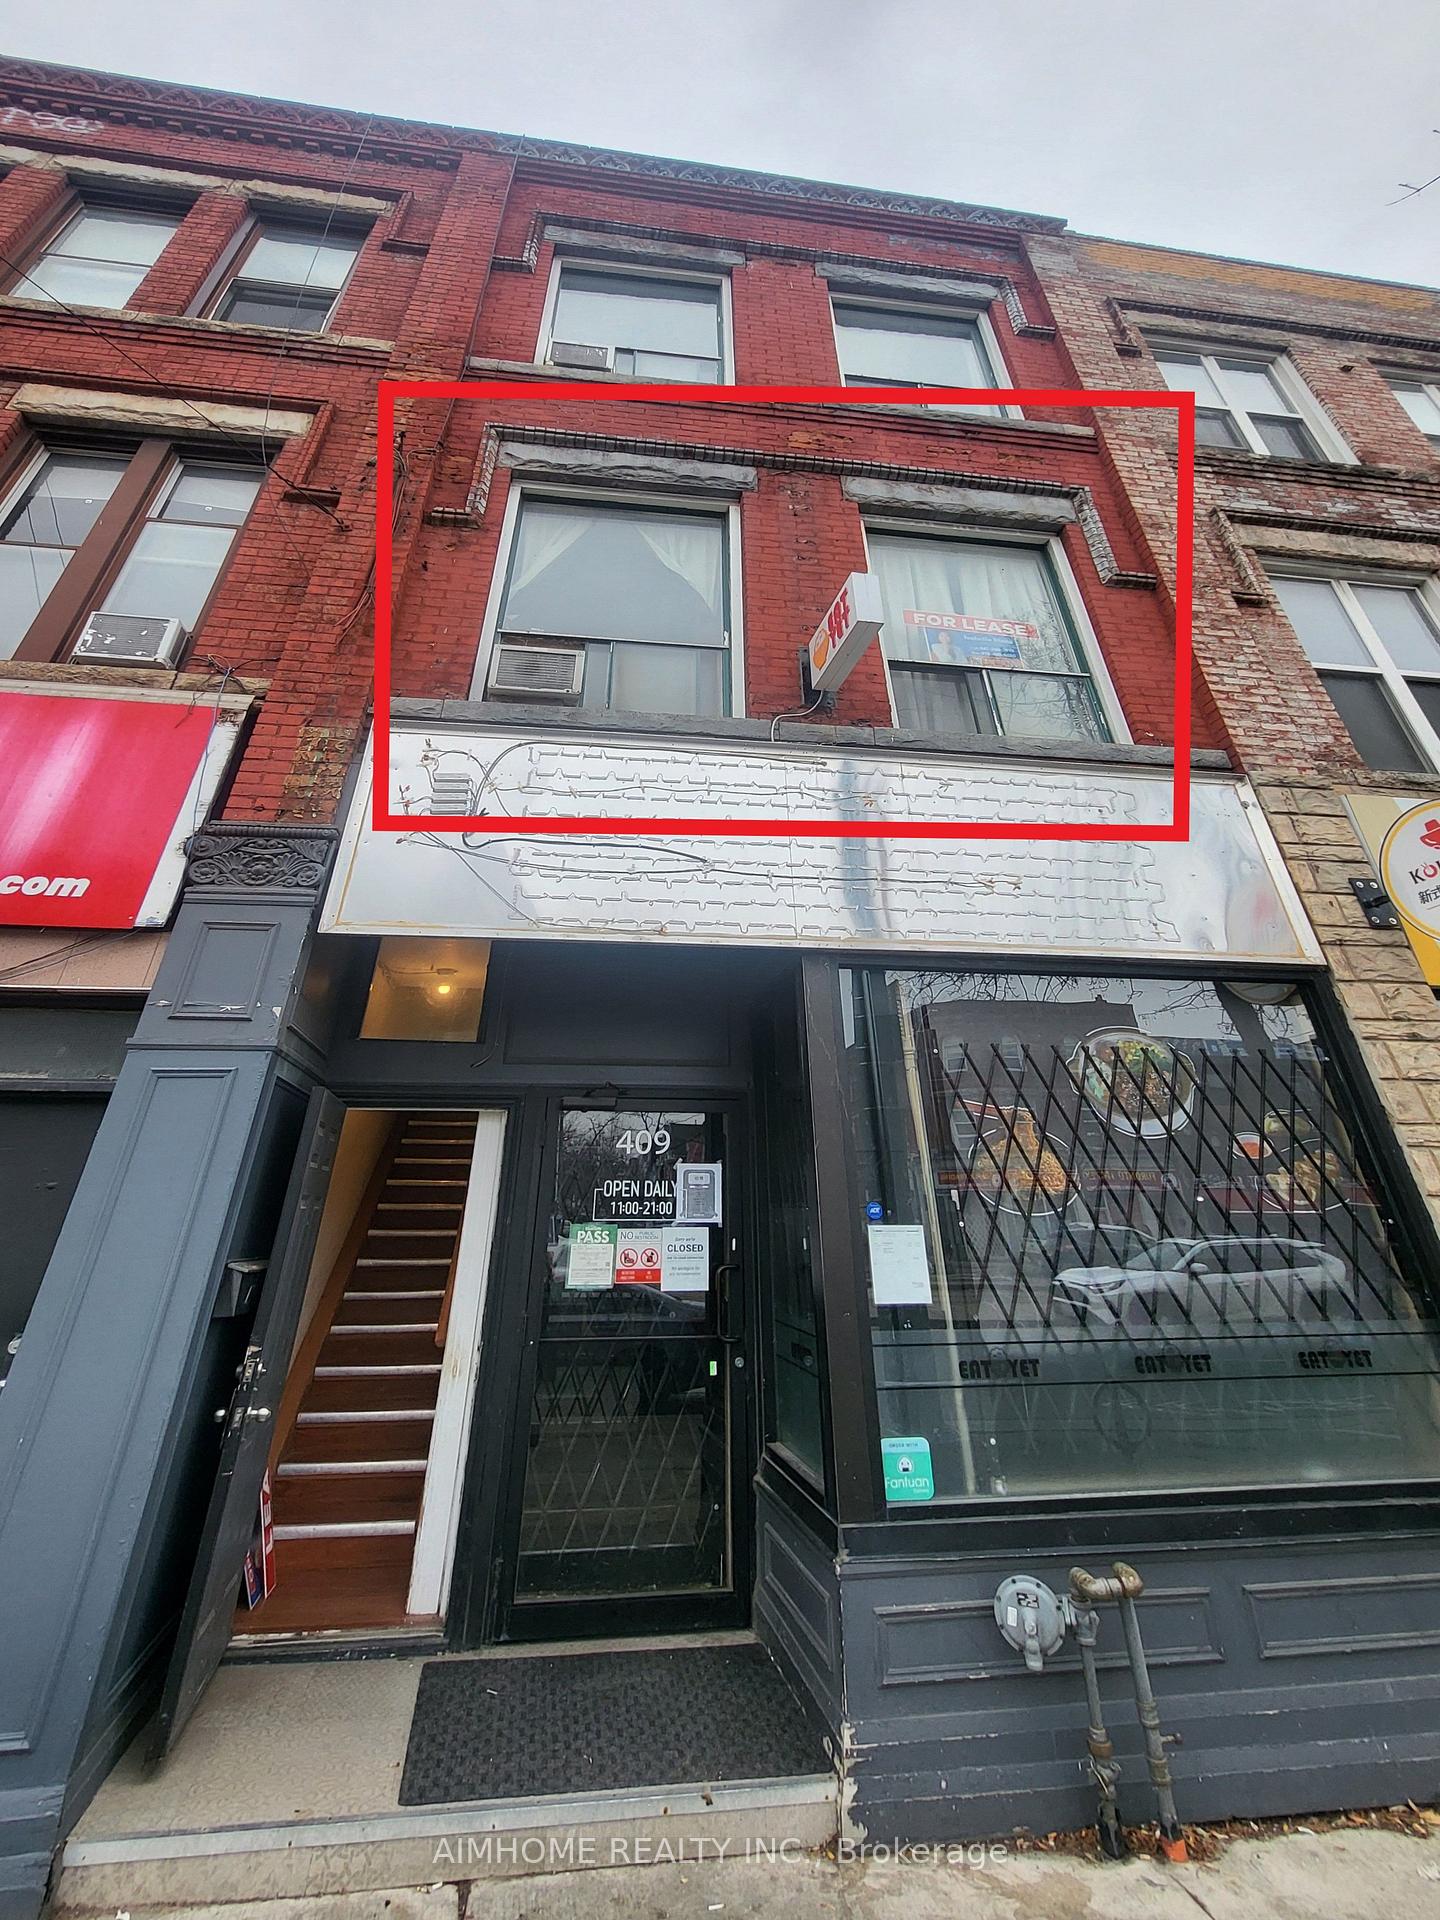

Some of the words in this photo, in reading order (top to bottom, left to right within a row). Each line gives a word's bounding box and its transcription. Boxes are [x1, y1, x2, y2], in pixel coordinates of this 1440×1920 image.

[913, 612, 956, 628] FOR
[961, 618, 1029, 636] LEASE
[1409, 860, 1440, 885] KO
[615, 1130, 671, 1155] 409
[603, 1180, 640, 1197] OPEN
[644, 1180, 678, 1197] DAILY
[610, 1201, 673, 1215] 11:00-21:00
[577, 1230, 610, 1244] PASS
[620, 1231, 634, 1240] NO
[667, 1243, 704, 1253] CLOSED
[958, 1360, 992, 1379] EAT
[1008, 1358, 1040, 1379] YET
[1134, 1355, 1166, 1374] EAT
[1180, 1353, 1212, 1373] YET
[1298, 1350, 1329, 1369] EAT
[1341, 1349, 1373, 1368] YET
